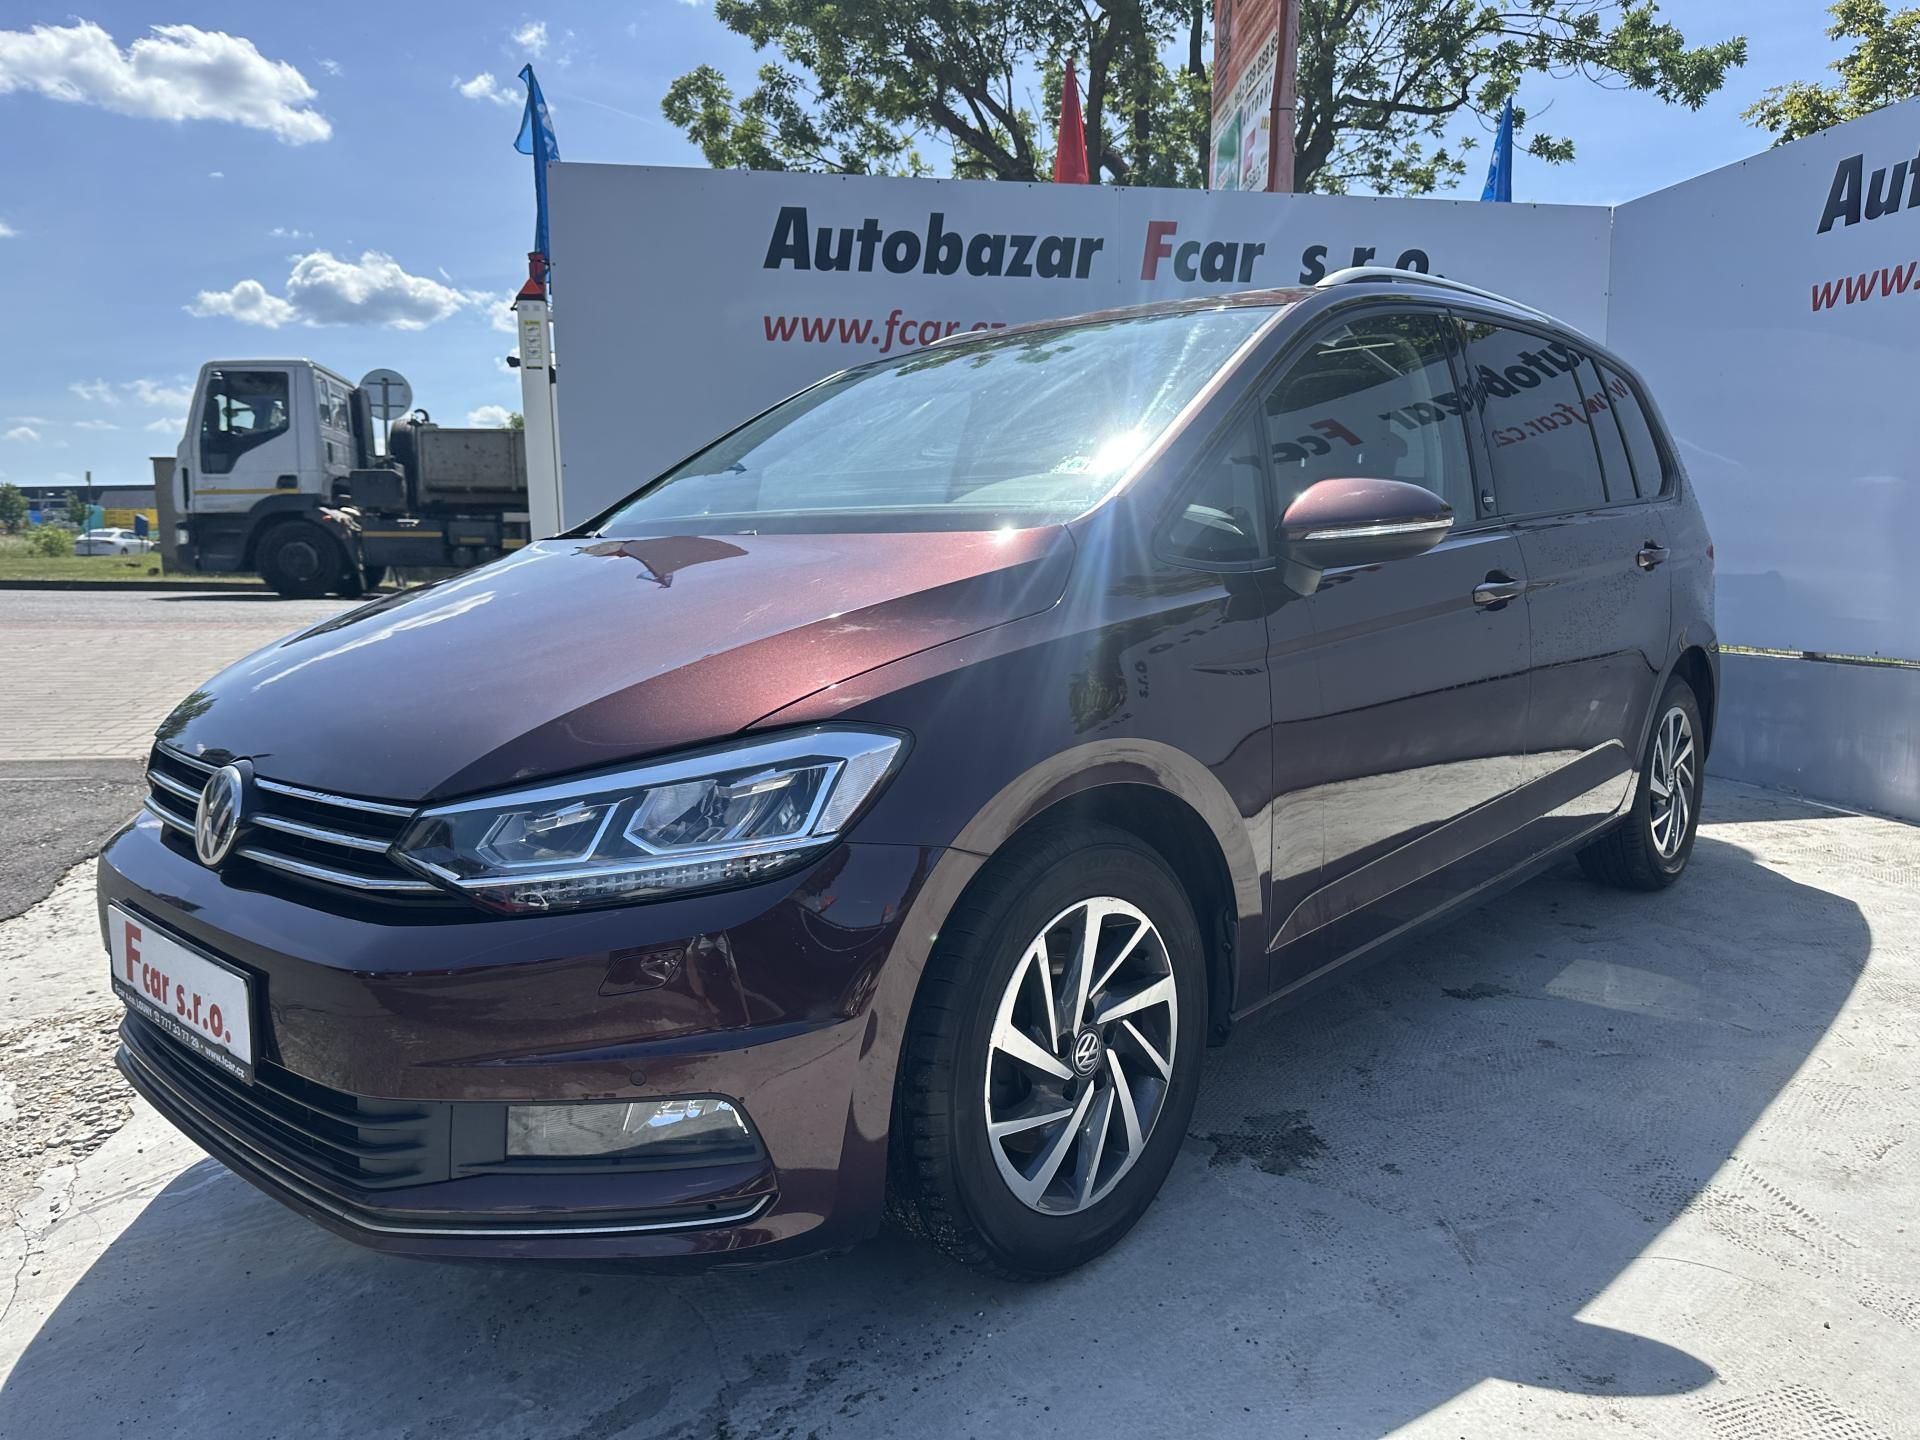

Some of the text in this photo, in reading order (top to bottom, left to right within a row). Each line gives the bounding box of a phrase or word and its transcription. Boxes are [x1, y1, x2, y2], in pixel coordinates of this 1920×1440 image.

[763, 206, 1445, 285] Autobazar Fcar sro
[763, 309, 1007, 353] www.fcar
[125, 920, 232, 1043] Fcar s.r.o.
